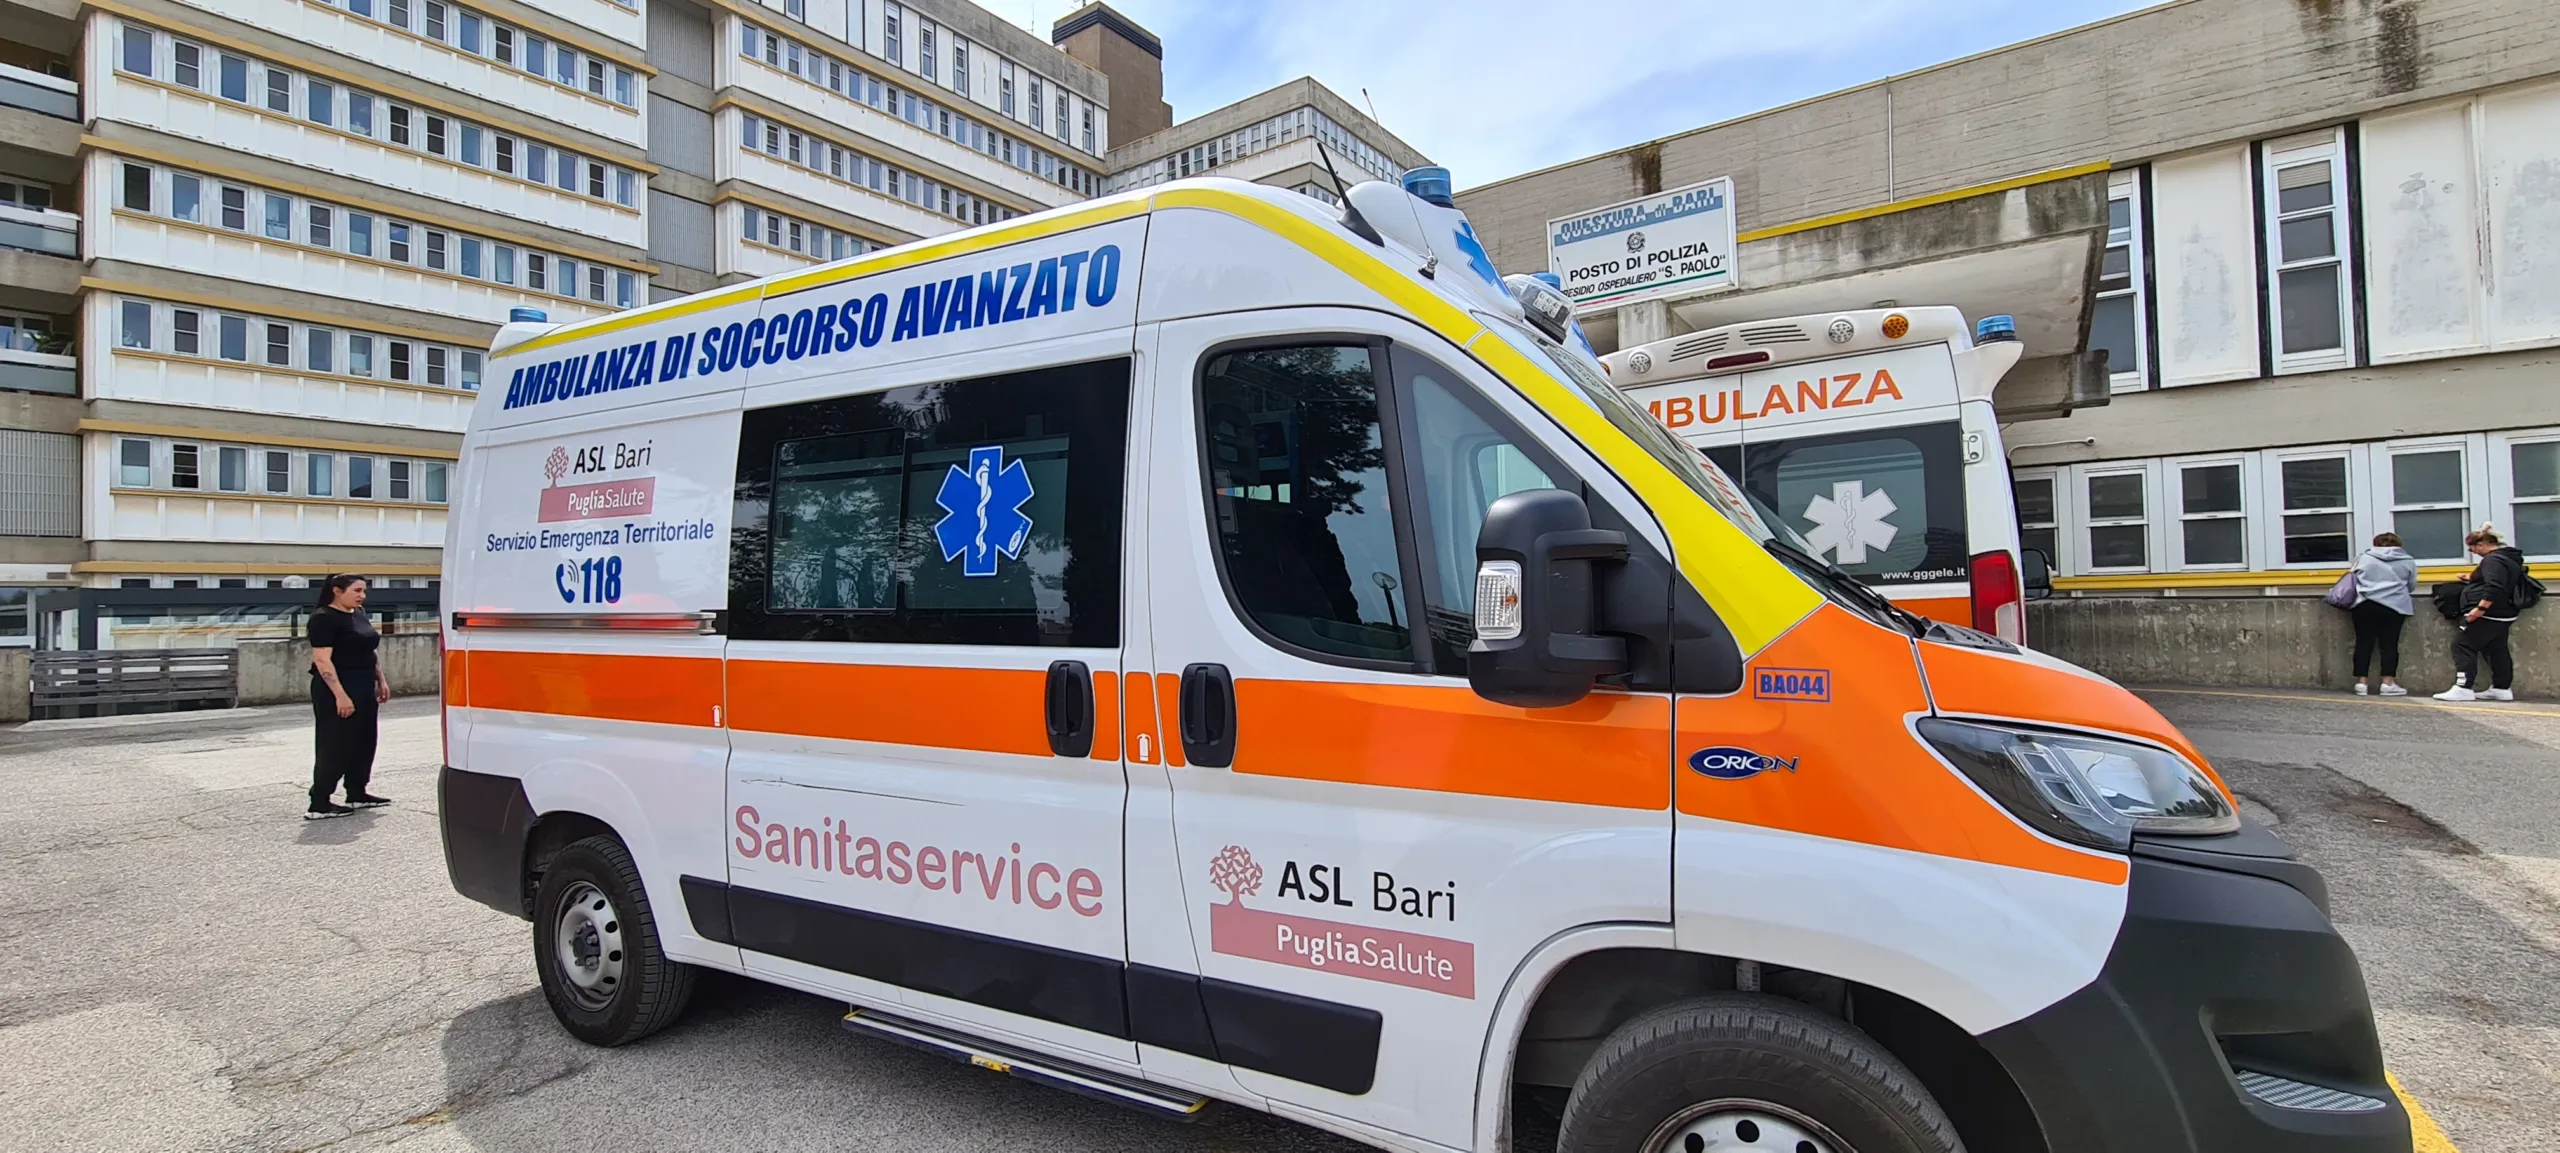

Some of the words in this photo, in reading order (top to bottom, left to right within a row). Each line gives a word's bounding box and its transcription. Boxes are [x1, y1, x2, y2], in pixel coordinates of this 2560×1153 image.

[1561, 205, 1647, 242] QUESTURA
[1655, 203, 1667, 218] di
[1672, 187, 1714, 212] BARI
[1570, 260, 1620, 282] POSTO
[1626, 254, 1641, 271] DI
[1648, 242, 1709, 266] POLIZIA
[1597, 271, 1657, 292] OSPEDALIERO
[503, 340, 657, 411] AMBULANZA
[658, 332, 696, 383] DI
[698, 292, 889, 377] SOCCORSO
[891, 243, 1121, 343] AVANZATO
[573, 446, 606, 475] ASL
[614, 439, 652, 470] Bari
[568, 488, 645, 516] PugliaSalute
[486, 531, 537, 552] Servizio
[540, 529, 619, 552] Emergenza
[624, 518, 714, 544] Territoriale
[581, 555, 622, 604] 118
[1881, 567, 1966, 580] www.gggele.it
[1760, 674, 1825, 695] BA044
[1703, 754, 1800, 773] ORION
[734, 804, 1103, 917] Sanitaservice
[1277, 860, 1353, 908] ASL
[1373, 872, 1457, 922] Bari
[1276, 923, 1454, 982] PugliaSalute
